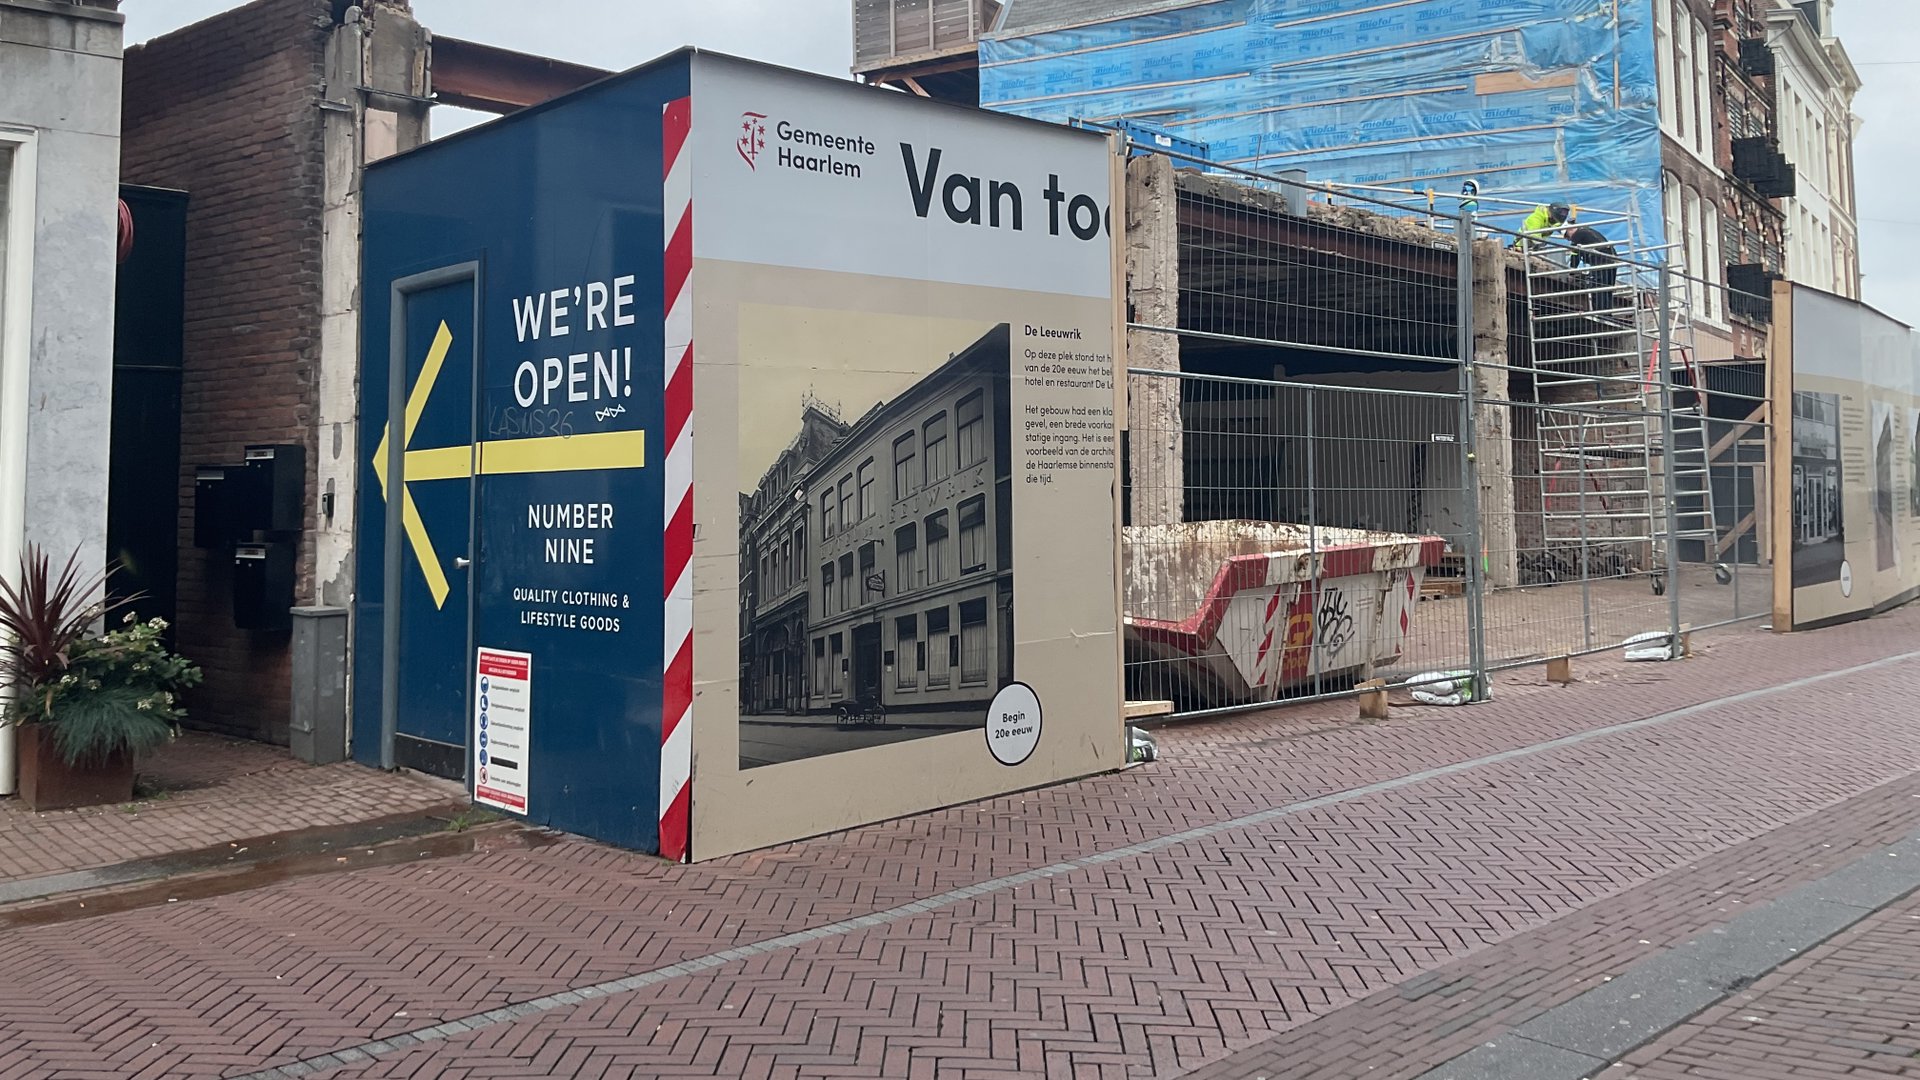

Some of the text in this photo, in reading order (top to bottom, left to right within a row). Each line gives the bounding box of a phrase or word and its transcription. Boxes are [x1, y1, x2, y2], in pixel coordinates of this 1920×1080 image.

[1359, 17, 1392, 29] miofol
[1302, 27, 1334, 38] miofol
[1422, 112, 1457, 124] miofol
[1485, 107, 1520, 119] miofol
[1362, 117, 1396, 129] miofol
[776, 120, 875, 156] Gemeente
[778, 147, 861, 179] Haarlem
[899, 142, 1111, 241] Van to
[1024, 324, 1082, 340] De Leeuwrik
[1024, 348, 1037, 361] Op
[1038, 350, 1057, 360] deze
[1058, 351, 1074, 362] plek
[1075, 353, 1095, 362] stond
[1096, 354, 1106, 363] tot
[1024, 364, 1039, 373] van
[1040, 363, 1051, 373] de
[1052, 365, 1066, 374] 20e
[1067, 367, 1087, 375] eeuw
[1088, 366, 1100, 376] het
[514, 347, 632, 408] OPEN!
[1025, 377, 1044, 386] hotel
[1056, 379, 1094, 388] restaurant
[1095, 380, 1106, 389] De
[1025, 405, 1038, 415] Het
[1040, 405, 1070, 417] gebouw
[1072, 406, 1087, 416] had
[1087, 408, 1101, 416] een
[1025, 418, 1048, 431] gevel,
[1049, 421, 1063, 429] een
[1065, 419, 1087, 429] brede
[1025, 432, 1051, 445] statige
[1052, 432, 1080, 445] ingang.
[1082, 433, 1095, 442] Het
[1096, 433, 1102, 443] is
[1025, 446, 1064, 456] voorbeeld
[1064, 448, 1079, 456] van
[1080, 446, 1090, 456] de
[1025, 459, 1114, 470] de Haarlemse binnensta
[1025, 474, 1054, 486] die tijd.
[528, 503, 613, 529] NUMBER
[545, 538, 594, 564] NINE
[513, 587, 630, 608] QUALITY CLOTHING &
[521, 610, 620, 632] LIFESTYLE GOODS
[1002, 710, 1026, 724] Begin
[994, 726, 1033, 739] 20e eeuw
